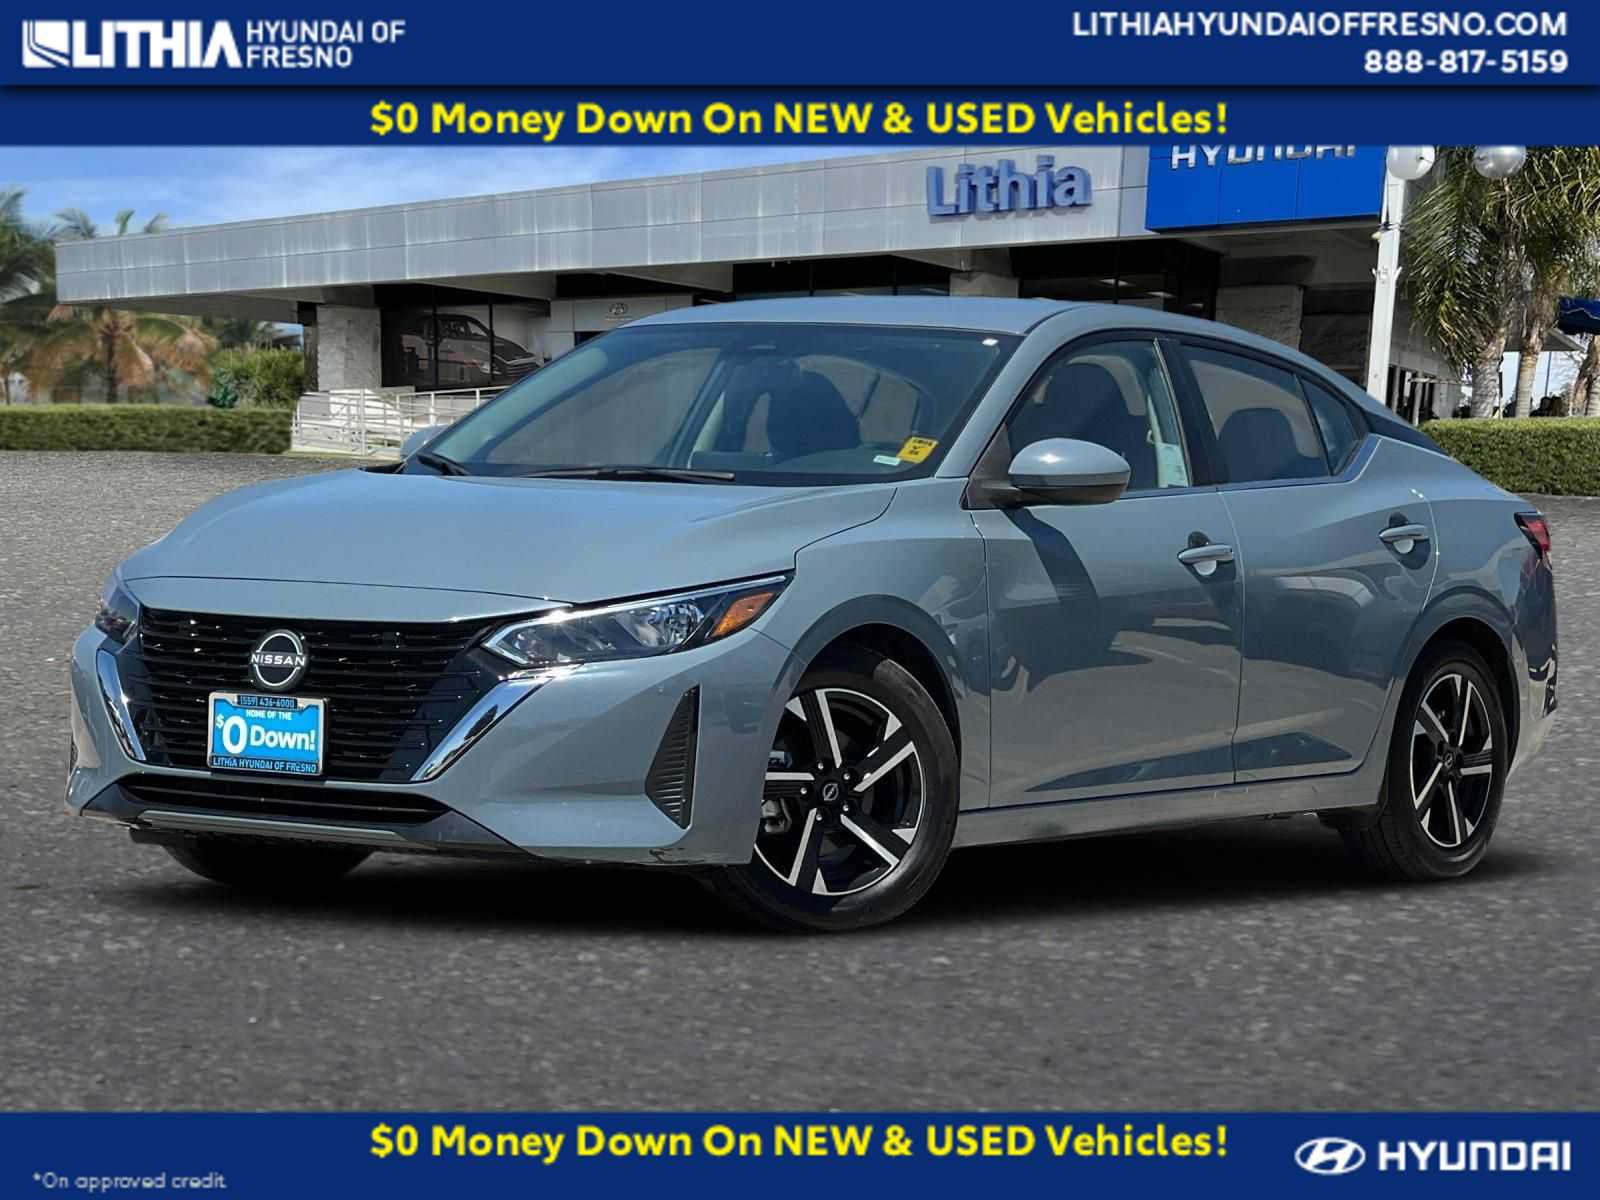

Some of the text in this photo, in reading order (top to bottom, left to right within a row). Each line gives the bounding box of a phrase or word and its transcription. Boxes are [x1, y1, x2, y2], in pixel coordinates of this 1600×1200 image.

[926, 154, 1093, 216] Lithia
[251, 653, 306, 667] NISSAN
[246, 709, 293, 721] HOME OF THE
[249, 724, 316, 751] Down!
[213, 756, 317, 774] LITHIA HYUNDAI OF FRESNO
